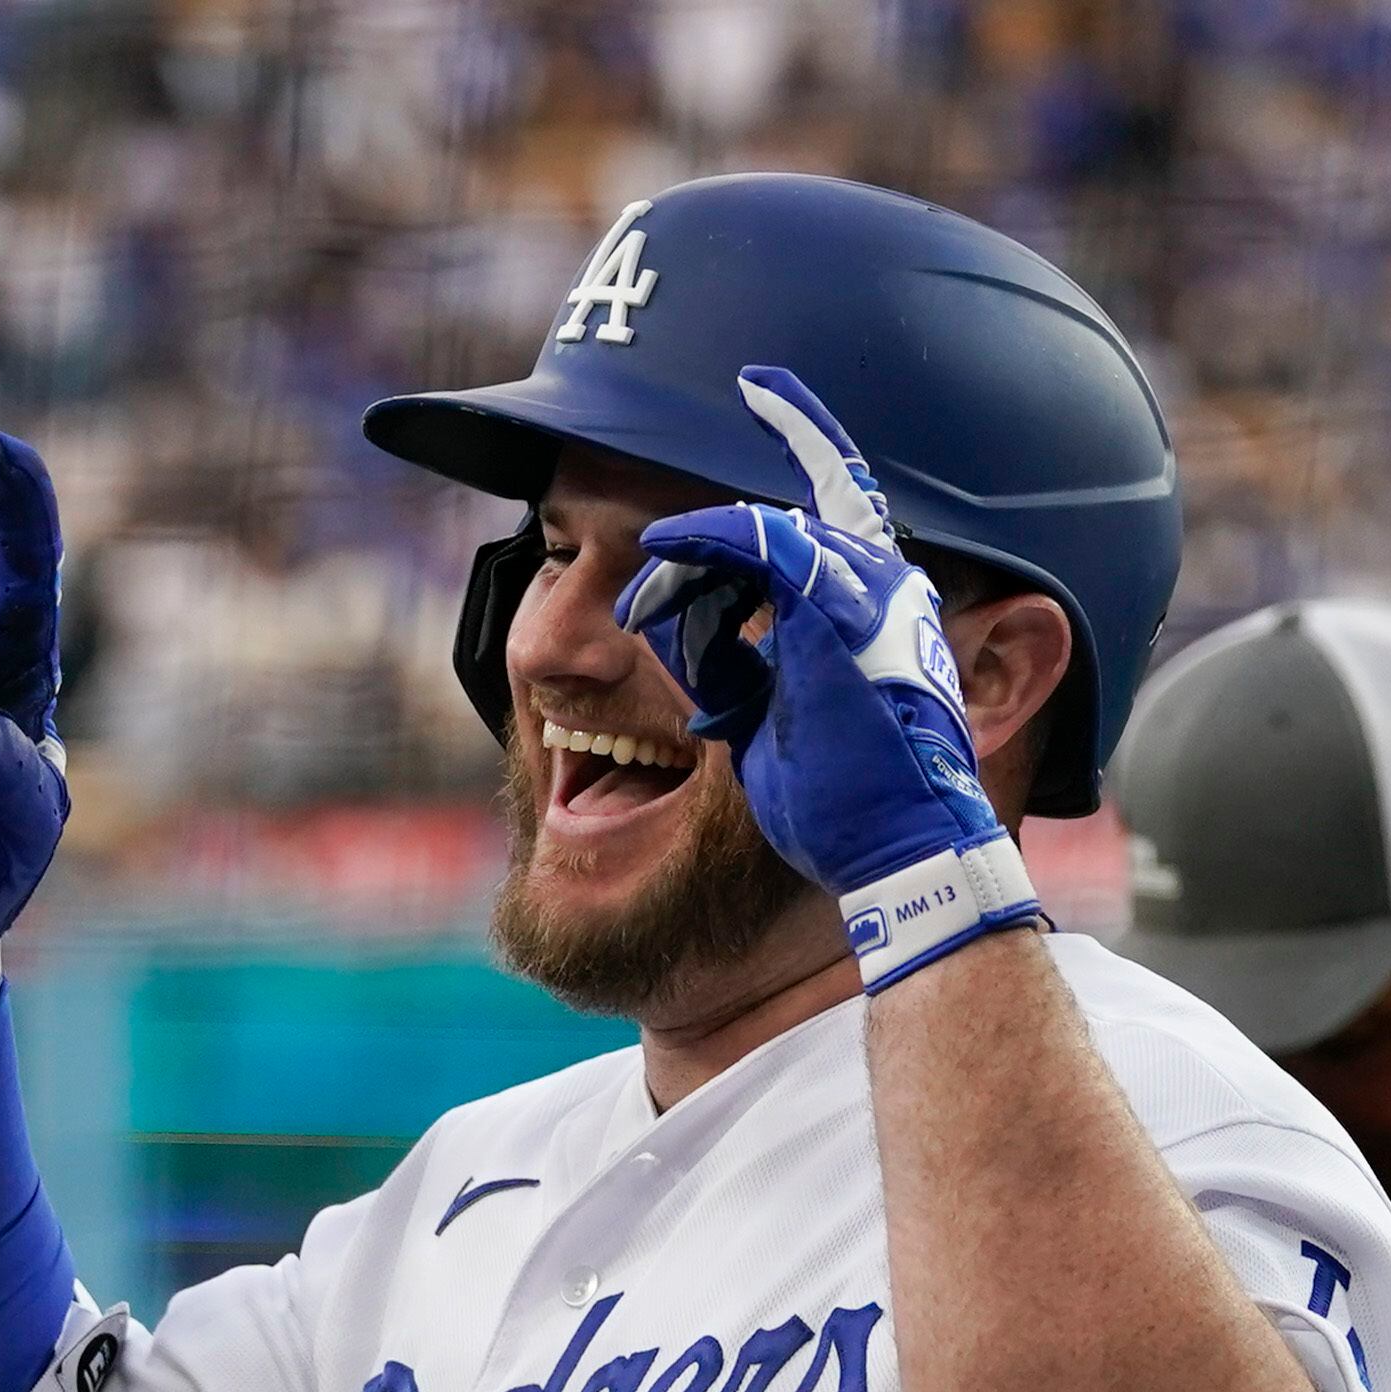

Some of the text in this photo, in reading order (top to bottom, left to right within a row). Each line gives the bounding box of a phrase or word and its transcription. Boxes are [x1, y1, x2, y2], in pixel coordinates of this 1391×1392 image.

[556, 199, 659, 345] LA
[895, 885, 957, 924] MM 13
